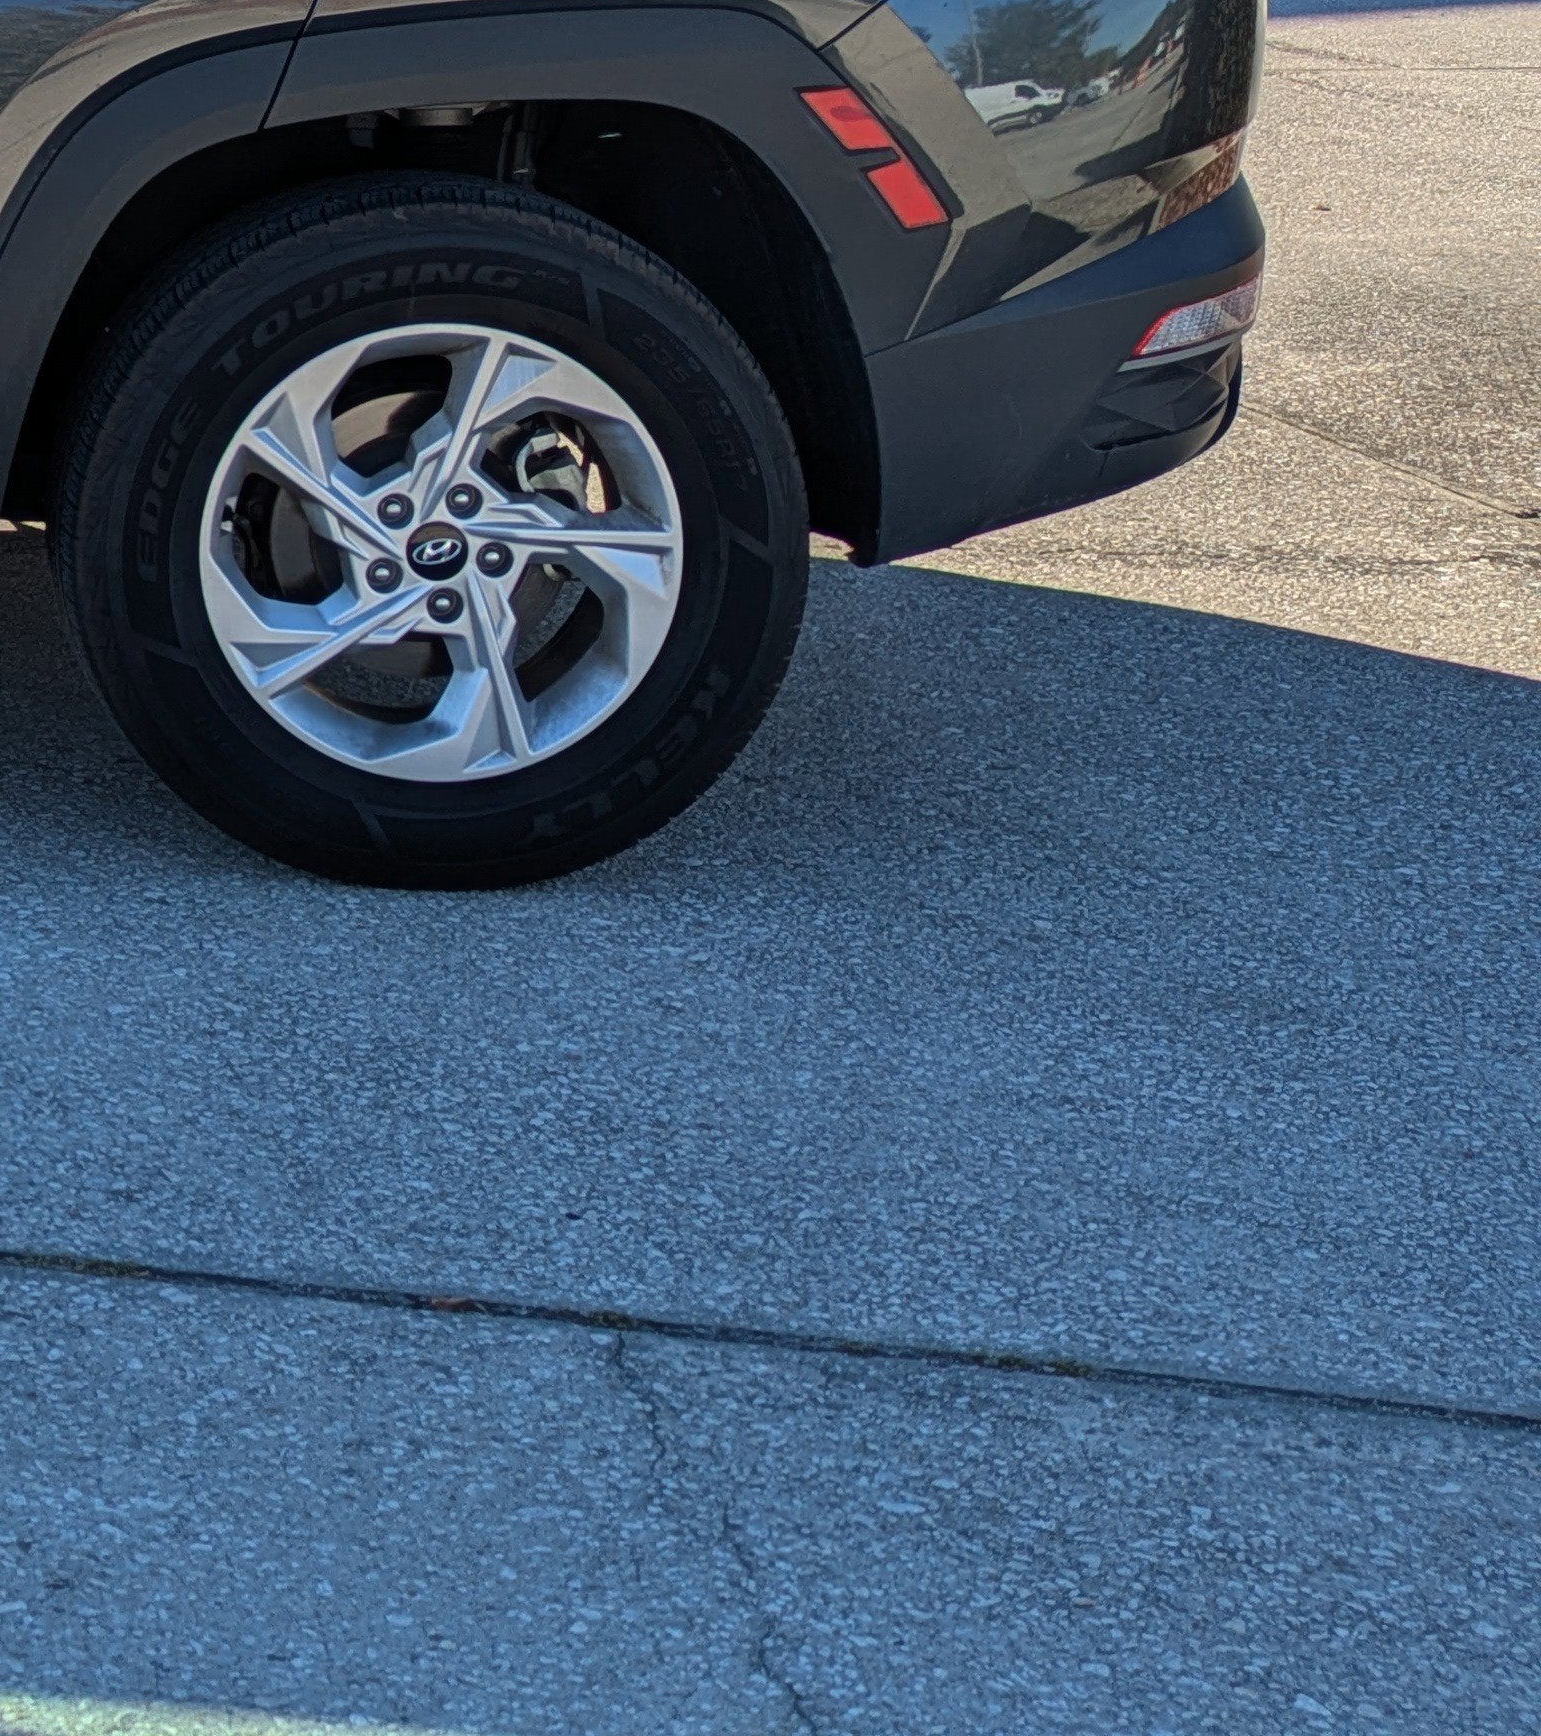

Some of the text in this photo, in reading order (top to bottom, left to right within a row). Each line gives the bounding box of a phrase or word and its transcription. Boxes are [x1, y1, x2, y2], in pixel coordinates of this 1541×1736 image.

[213, 263, 526, 378] TOURING
[134, 400, 202, 584] EDGE
[532, 665, 732, 839] KELLY
